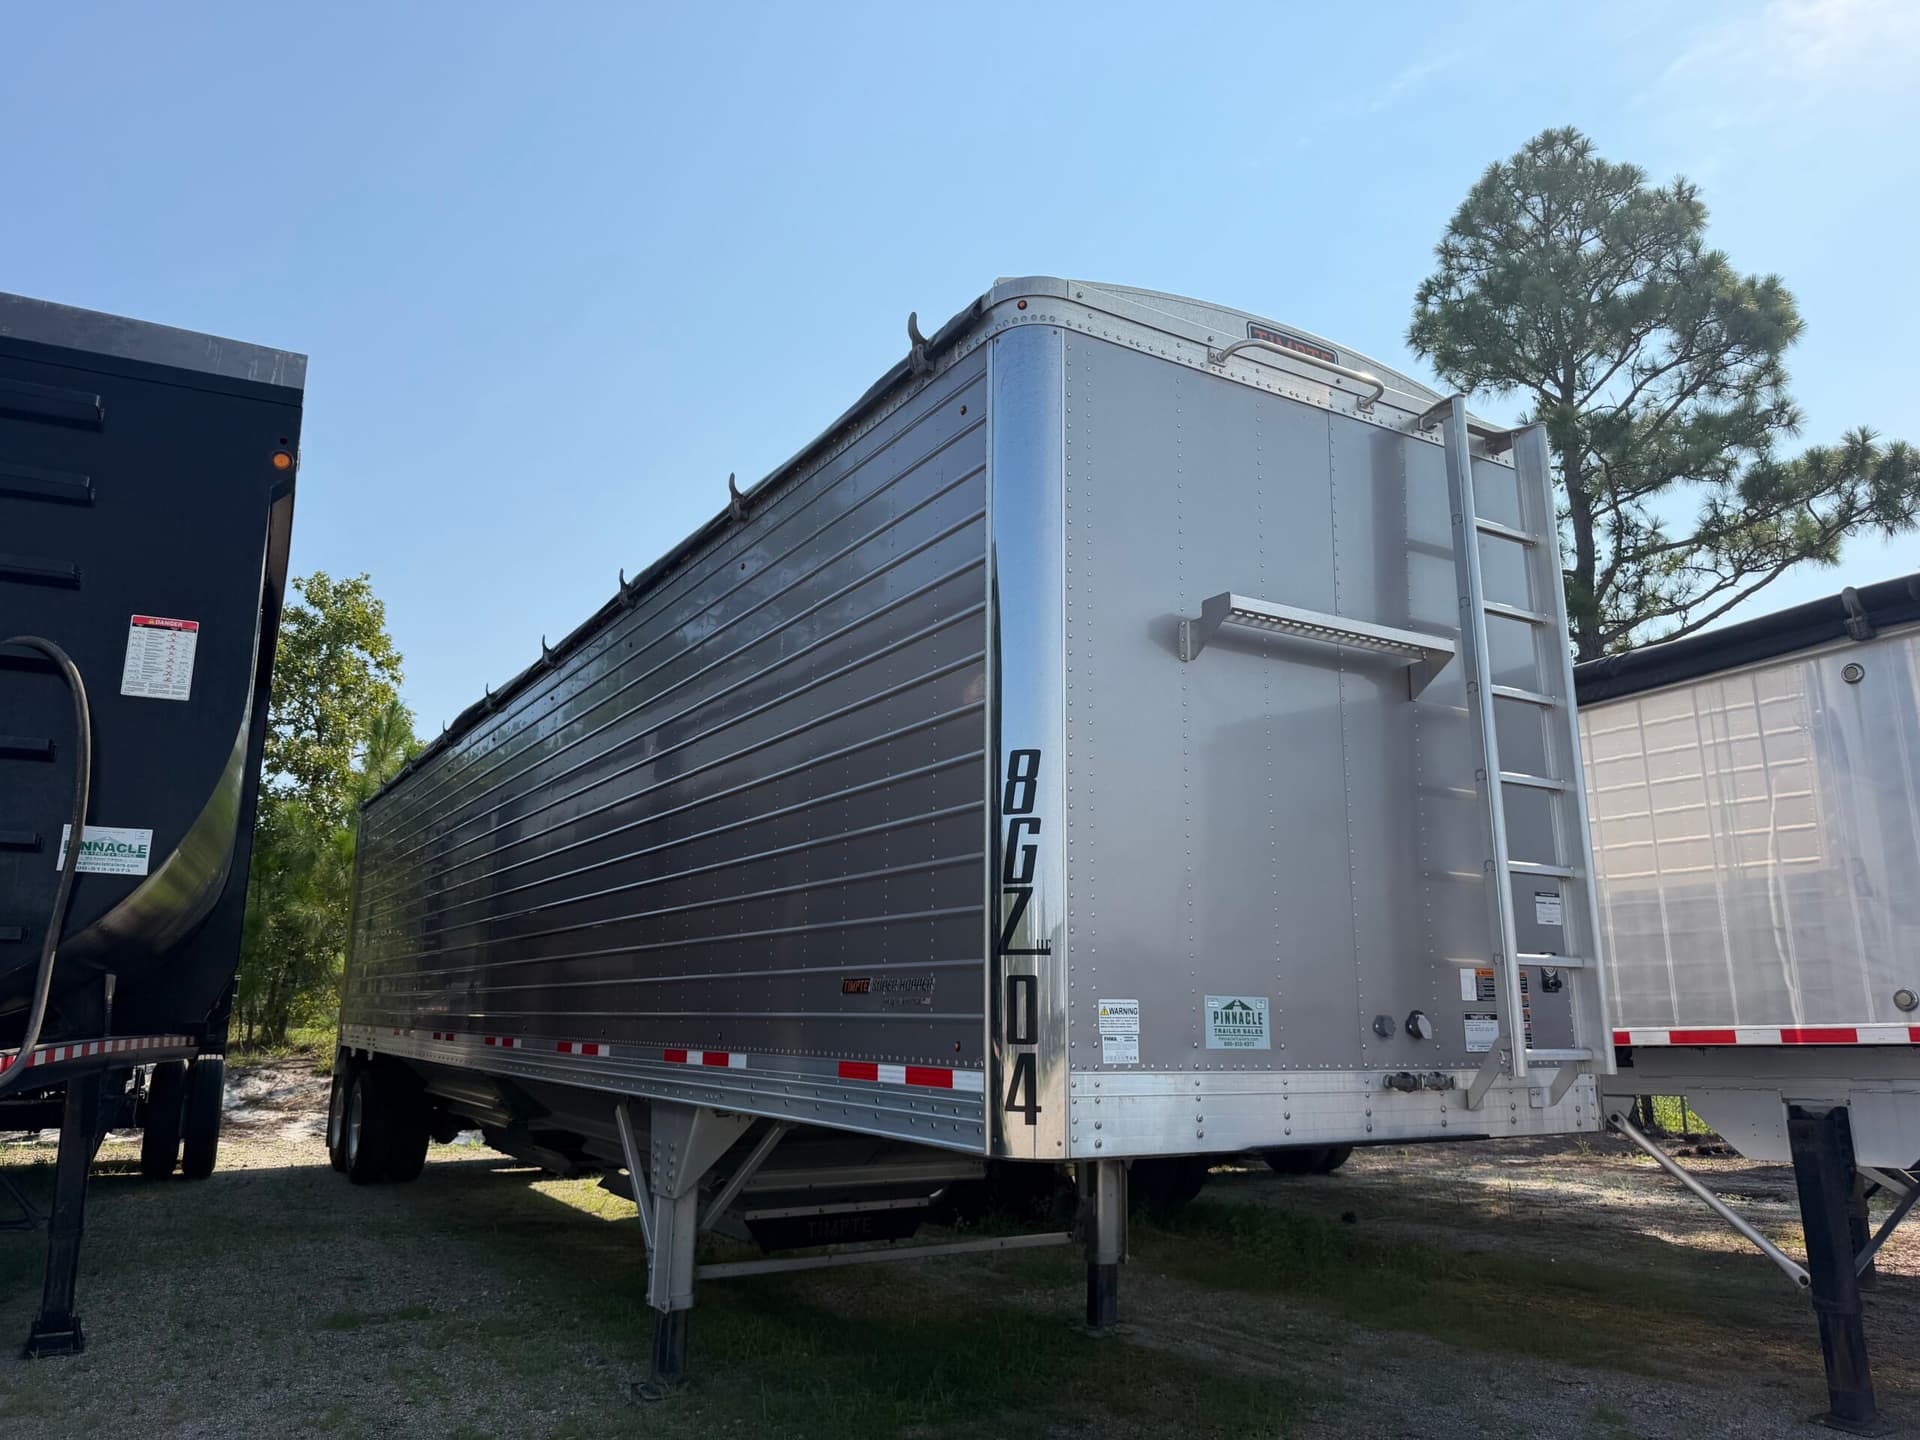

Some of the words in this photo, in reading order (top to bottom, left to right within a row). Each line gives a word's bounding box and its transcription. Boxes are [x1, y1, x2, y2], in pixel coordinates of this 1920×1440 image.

[155, 620, 183, 628] DANGER
[844, 980, 870, 993] TIMPTE
[1109, 1007, 1138, 1016] WARNING
[1213, 1010, 1263, 1025] PINNACLE
[808, 1216, 873, 1240] TIMPTE
